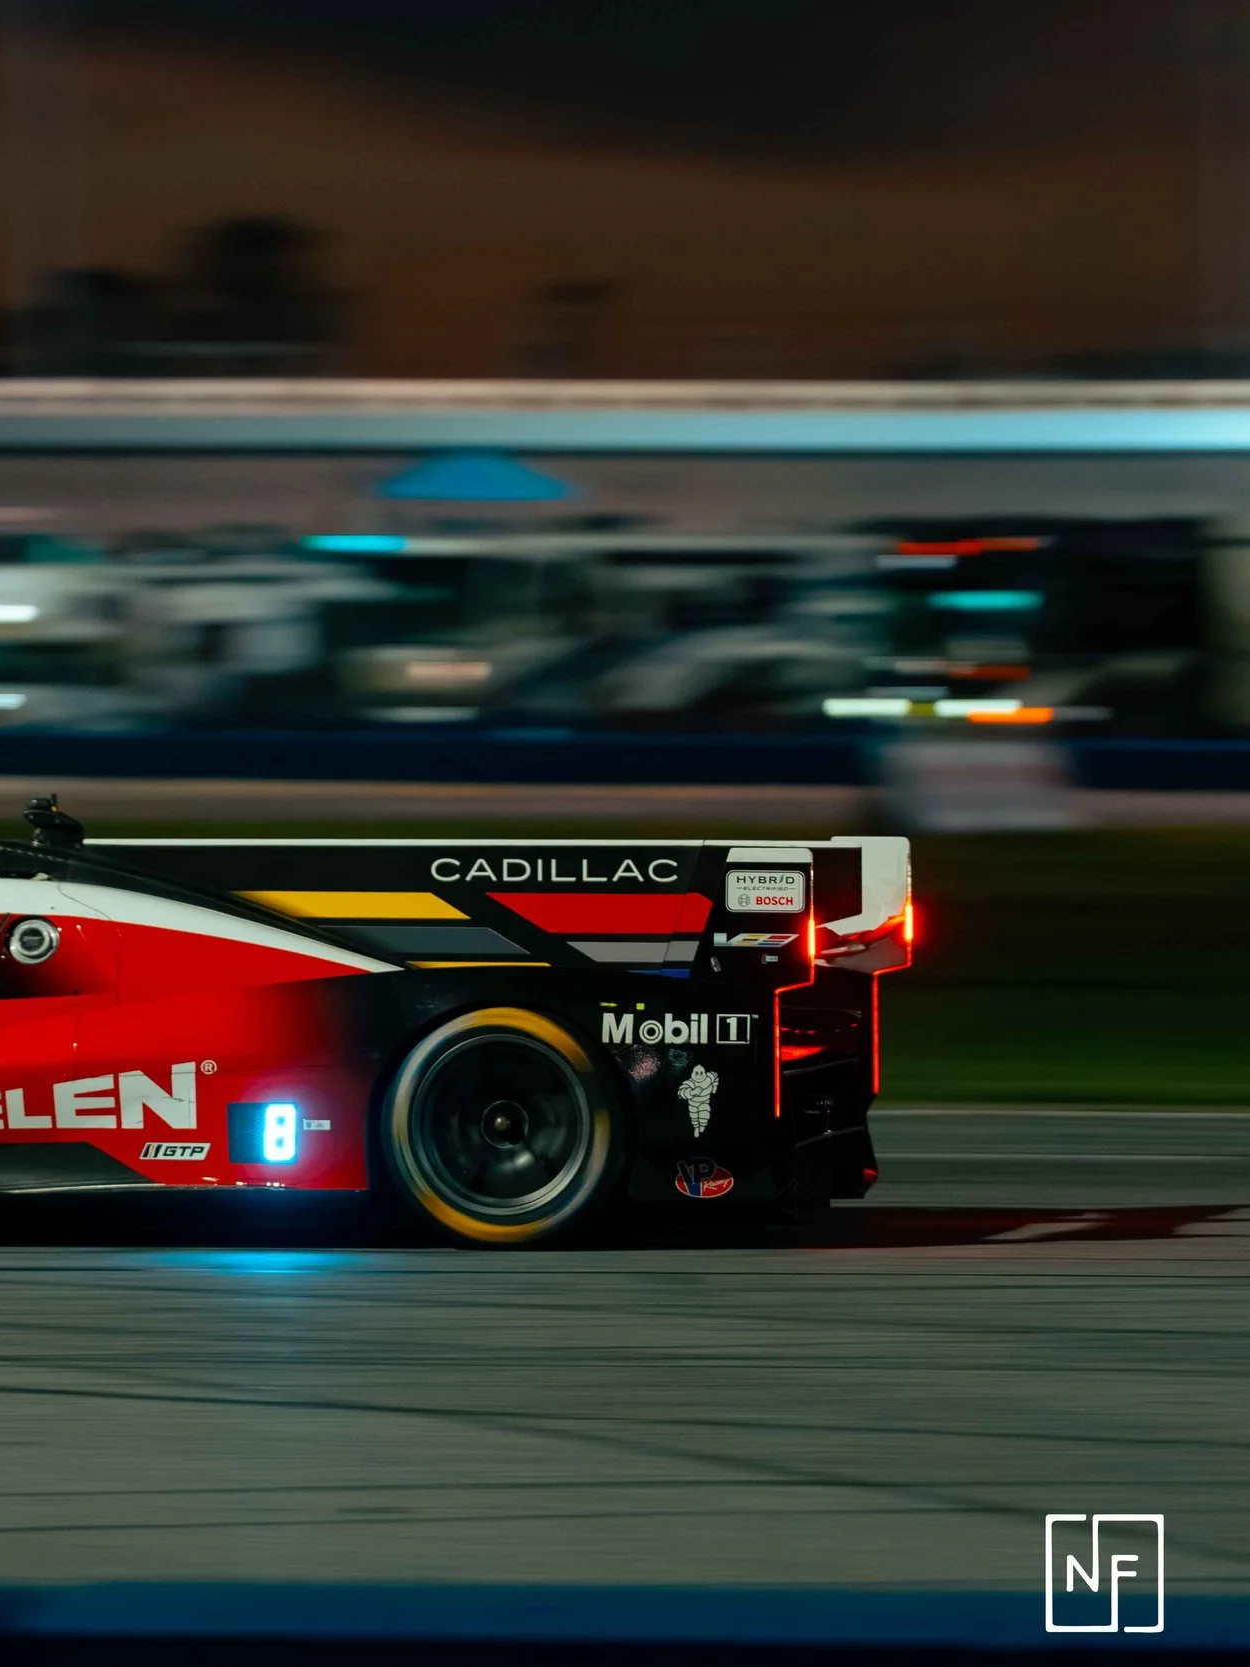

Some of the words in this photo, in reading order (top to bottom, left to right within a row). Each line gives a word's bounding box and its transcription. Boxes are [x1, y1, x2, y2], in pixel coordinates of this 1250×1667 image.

[430, 858, 678, 882] CADILLAC
[736, 875, 795, 884] HYBRID
[755, 896, 794, 906] BOSCH
[601, 1012, 709, 1045] Mobil
[264, 1103, 297, 1162] 8
[163, 1145, 205, 1157] GTP
